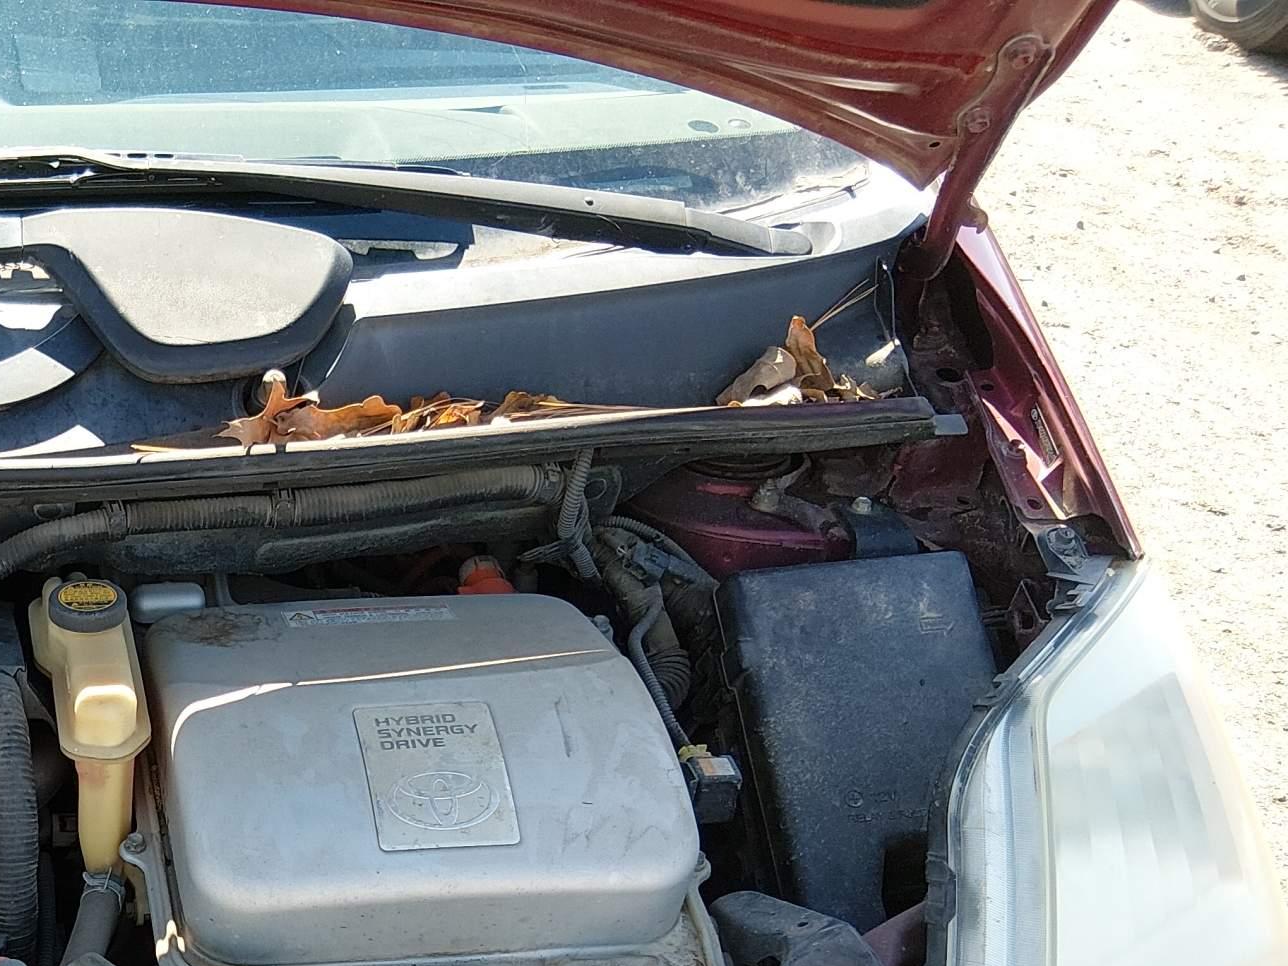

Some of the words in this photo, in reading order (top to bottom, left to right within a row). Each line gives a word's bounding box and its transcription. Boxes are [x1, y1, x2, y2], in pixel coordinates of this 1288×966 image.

[374, 714, 456, 727] HYBRID
[377, 723, 478, 739] SYNERGY
[380, 738, 446, 751] DRIVE
